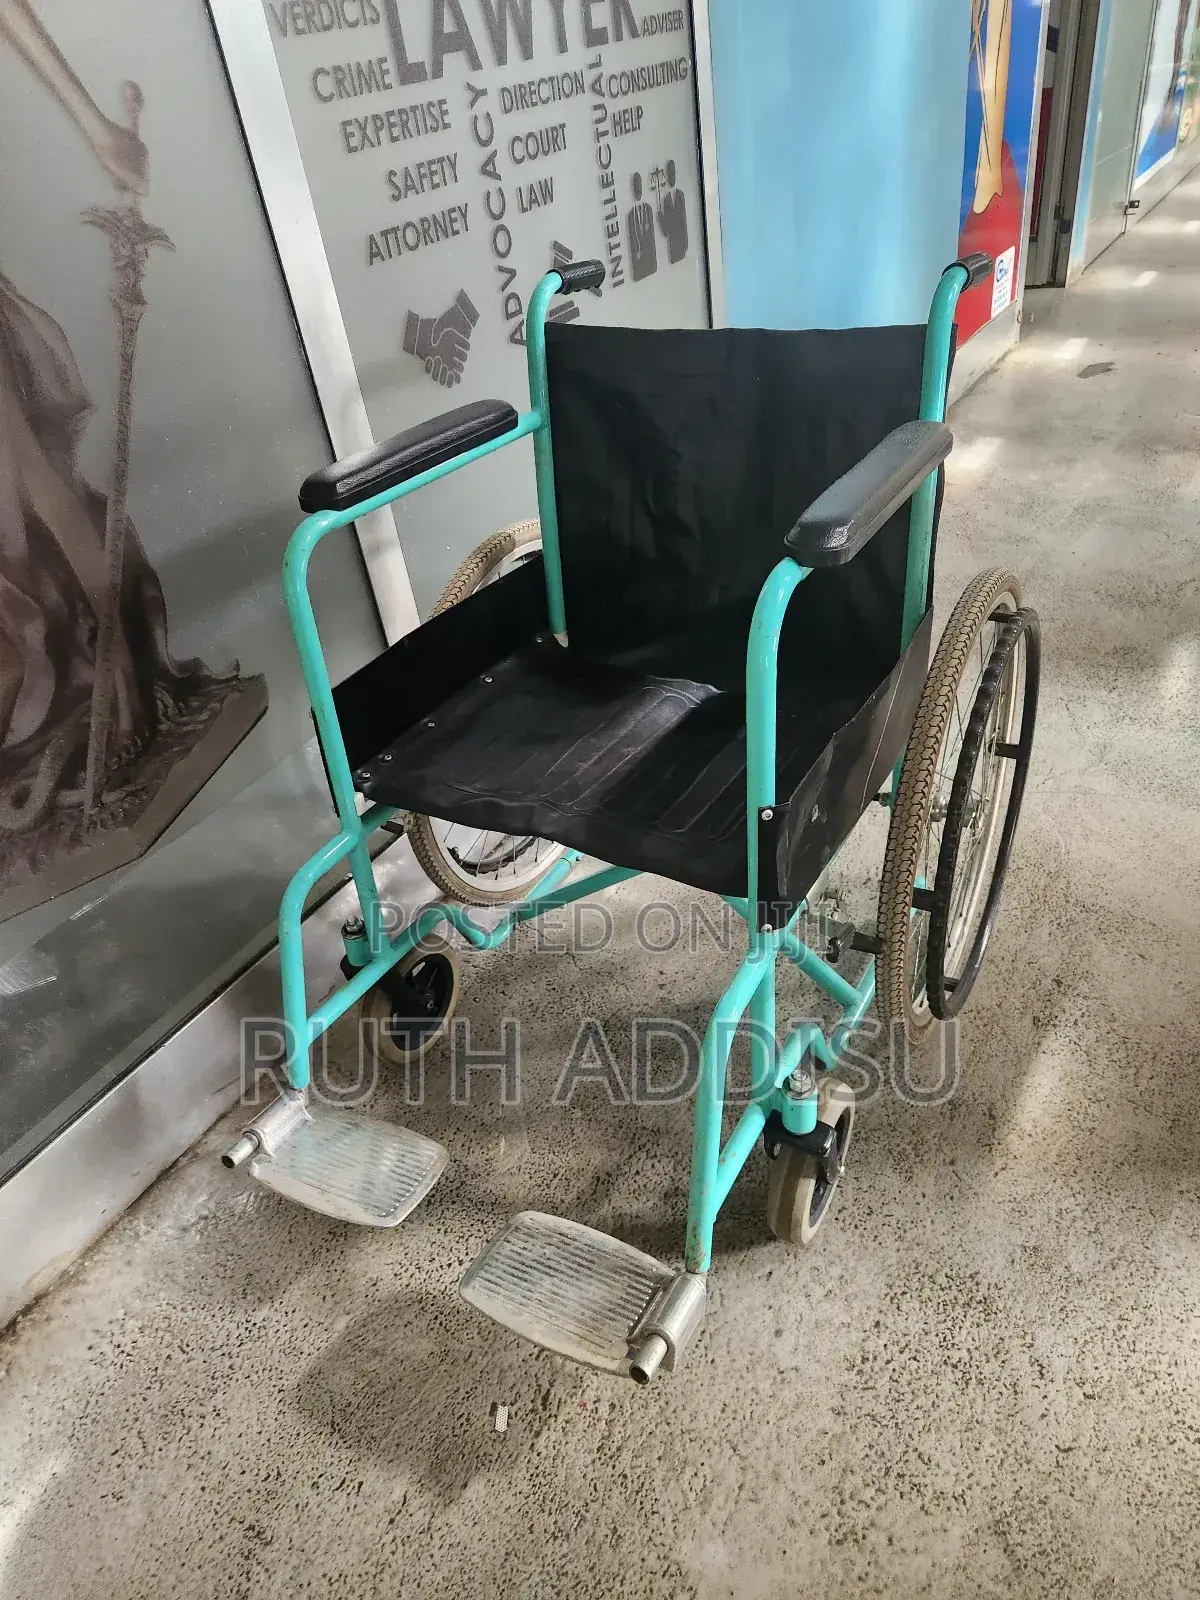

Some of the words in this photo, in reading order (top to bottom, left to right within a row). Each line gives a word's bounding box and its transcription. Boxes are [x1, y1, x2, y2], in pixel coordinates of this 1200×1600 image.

[642, 9, 685, 37] ADVISER
[312, 56, 393, 103] CRIME
[500, 69, 585, 114] DIRECTION
[608, 57, 689, 99] CONSULTING
[341, 98, 451, 153] EXPERTISE
[510, 122, 567, 164] COURT
[612, 105, 644, 137] HELP
[387, 153, 459, 202] SAFETY
[588, 53, 625, 288] INTELLECTUAL
[466, 81, 527, 346] ADVOCACY
[518, 176, 554, 213] LAW
[368, 203, 469, 265] ATTORNEY
